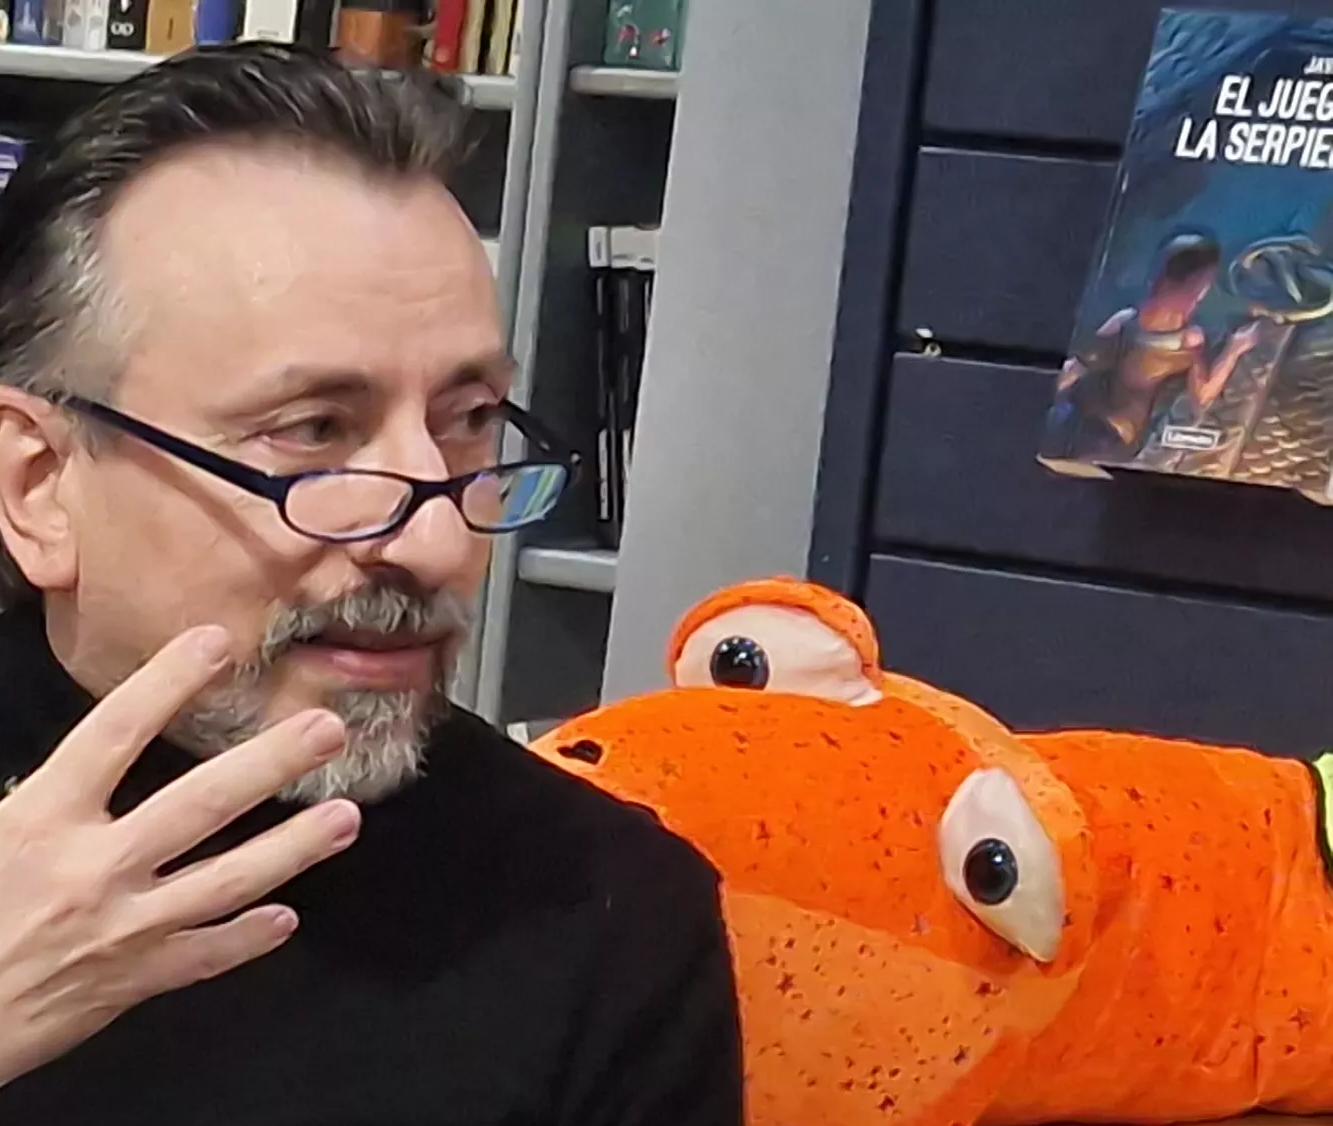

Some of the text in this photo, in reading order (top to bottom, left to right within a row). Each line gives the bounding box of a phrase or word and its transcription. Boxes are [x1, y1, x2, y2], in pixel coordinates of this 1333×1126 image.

[1215, 74, 1333, 122] EL JUEG
[1174, 117, 1333, 169] LA SERPIE
